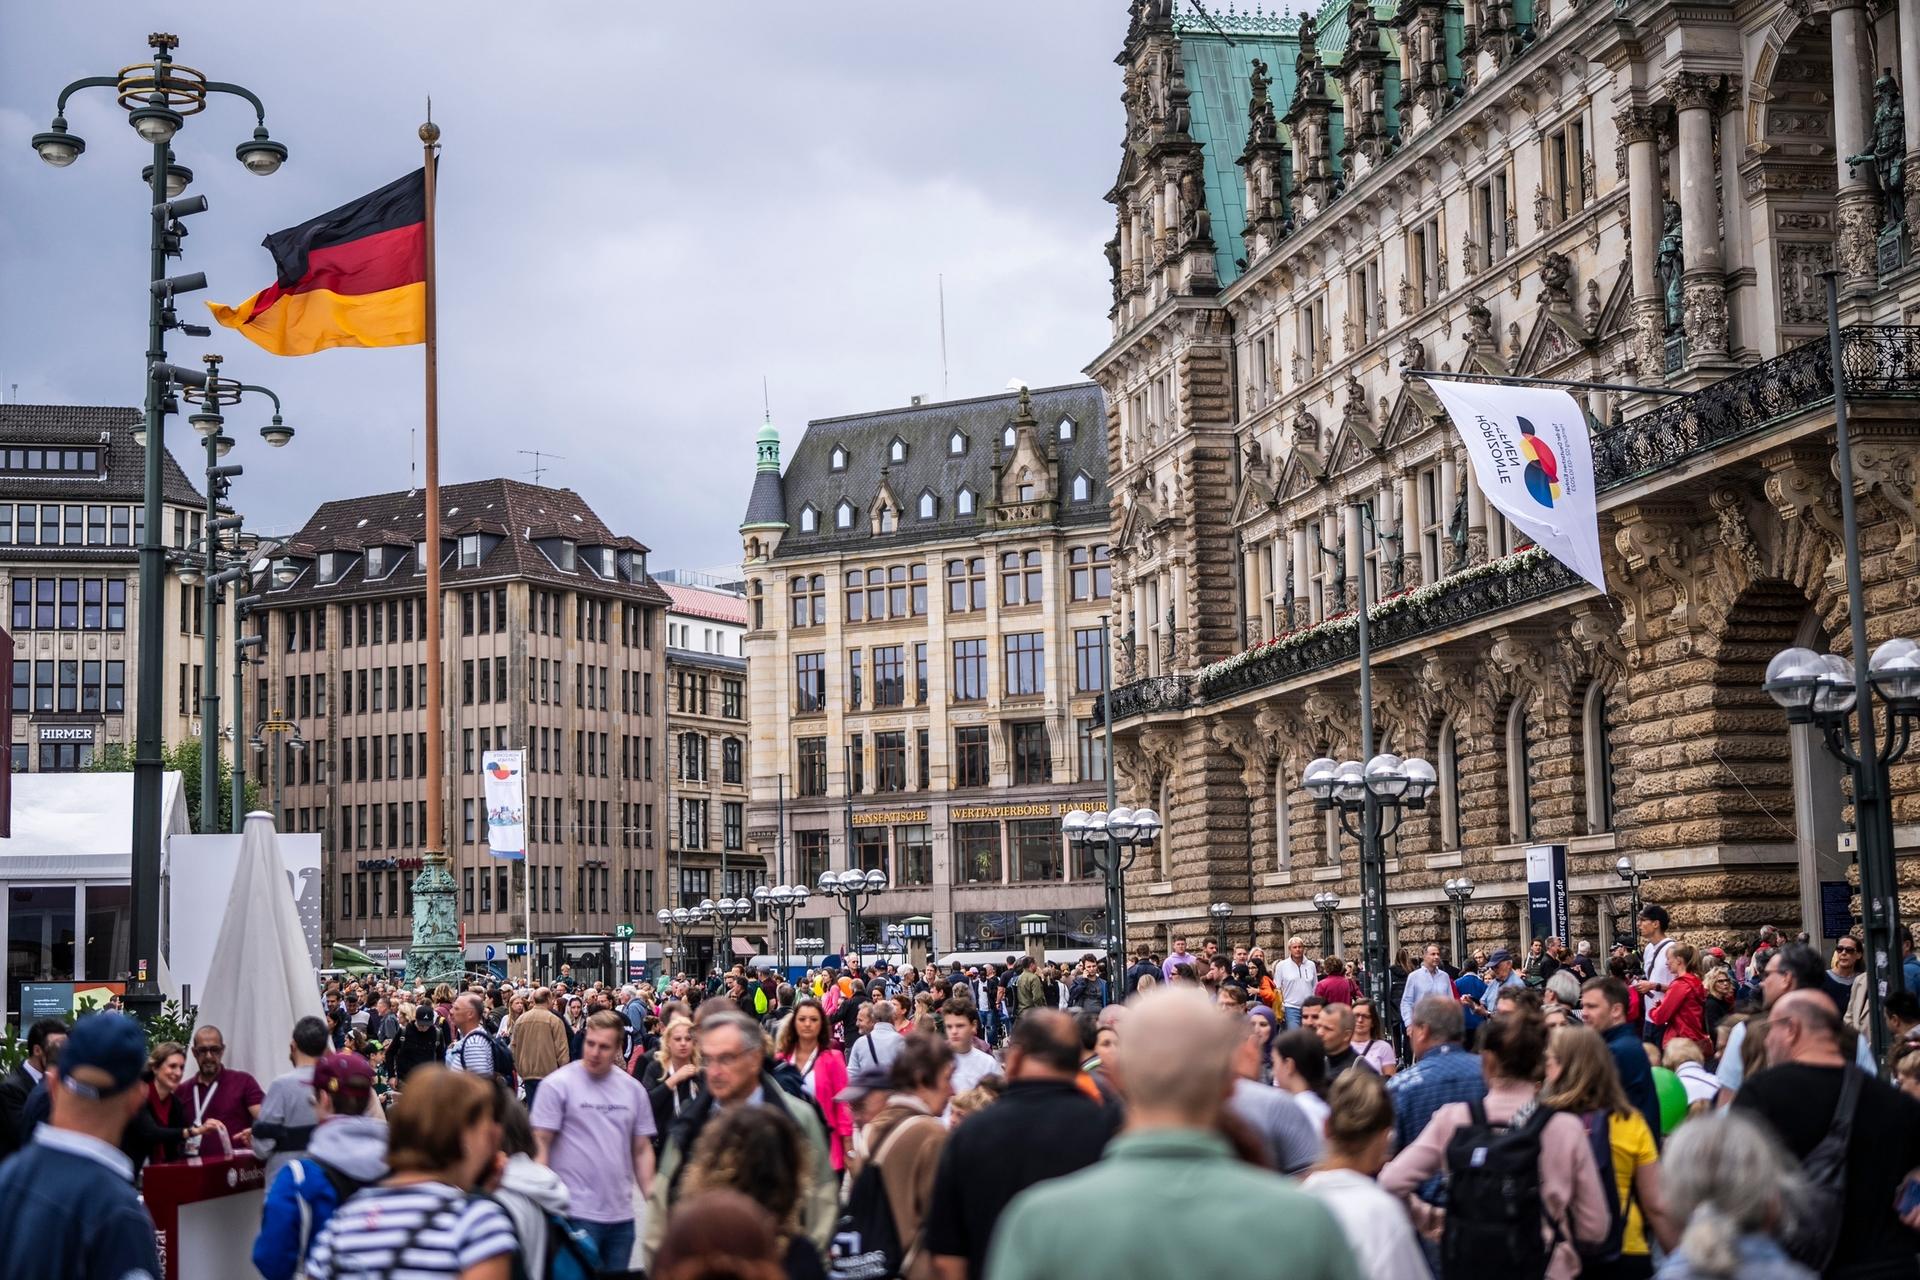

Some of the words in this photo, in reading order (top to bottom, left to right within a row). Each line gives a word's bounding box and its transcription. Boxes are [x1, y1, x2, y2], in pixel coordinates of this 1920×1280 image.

[40, 728, 92, 739] HIRMER
[852, 810, 927, 825] HANSEATISCHE
[952, 803, 1051, 818] WERTPAPIERBÖRSE
[1058, 801, 1108, 813] HAMBUR
[1556, 879, 1567, 947] ndesregierung.de
[981, 926, 990, 938] G
[1083, 922, 1093, 935] G
